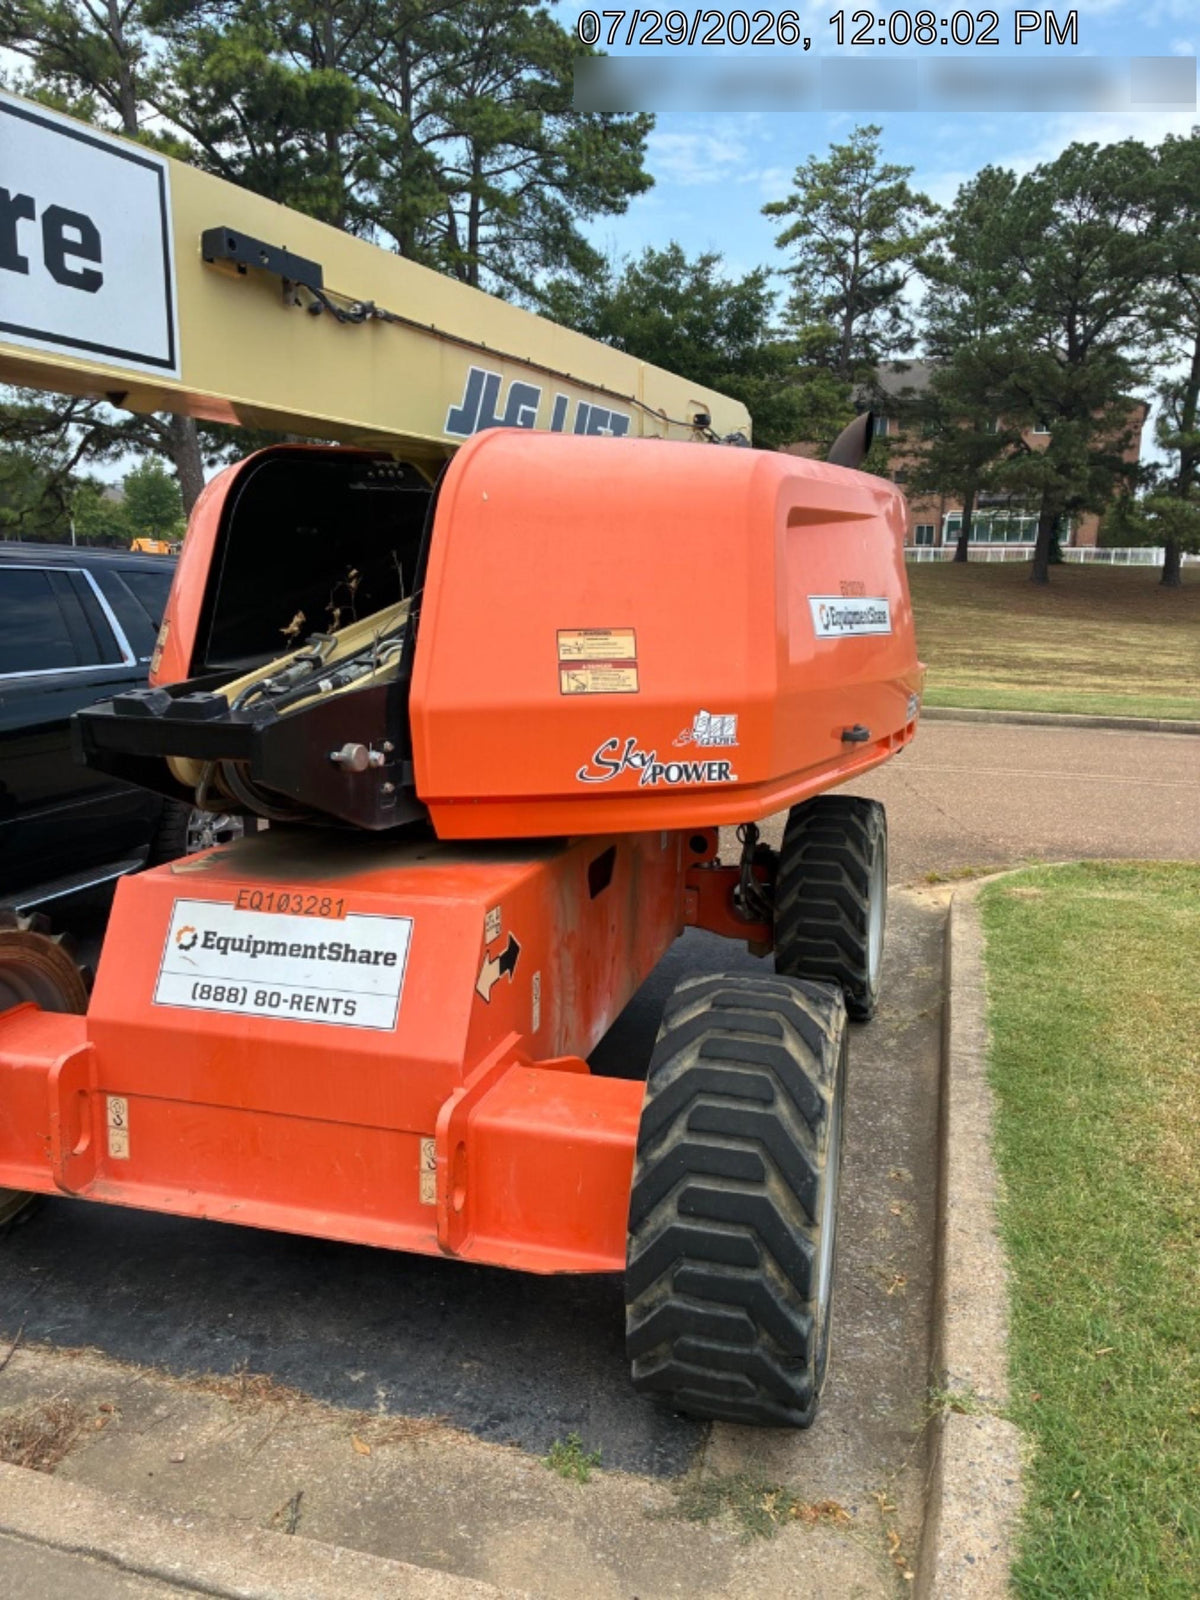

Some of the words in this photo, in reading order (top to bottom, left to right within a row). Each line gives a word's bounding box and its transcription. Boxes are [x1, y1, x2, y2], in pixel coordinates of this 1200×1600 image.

[444, 365, 542, 437] JLG
[236, 889, 345, 918] EQ103281
[201, 930, 398, 968] EquipmentShare
[191, 982, 247, 1006] (888)
[254, 990, 357, 1016] 80-RENTS
